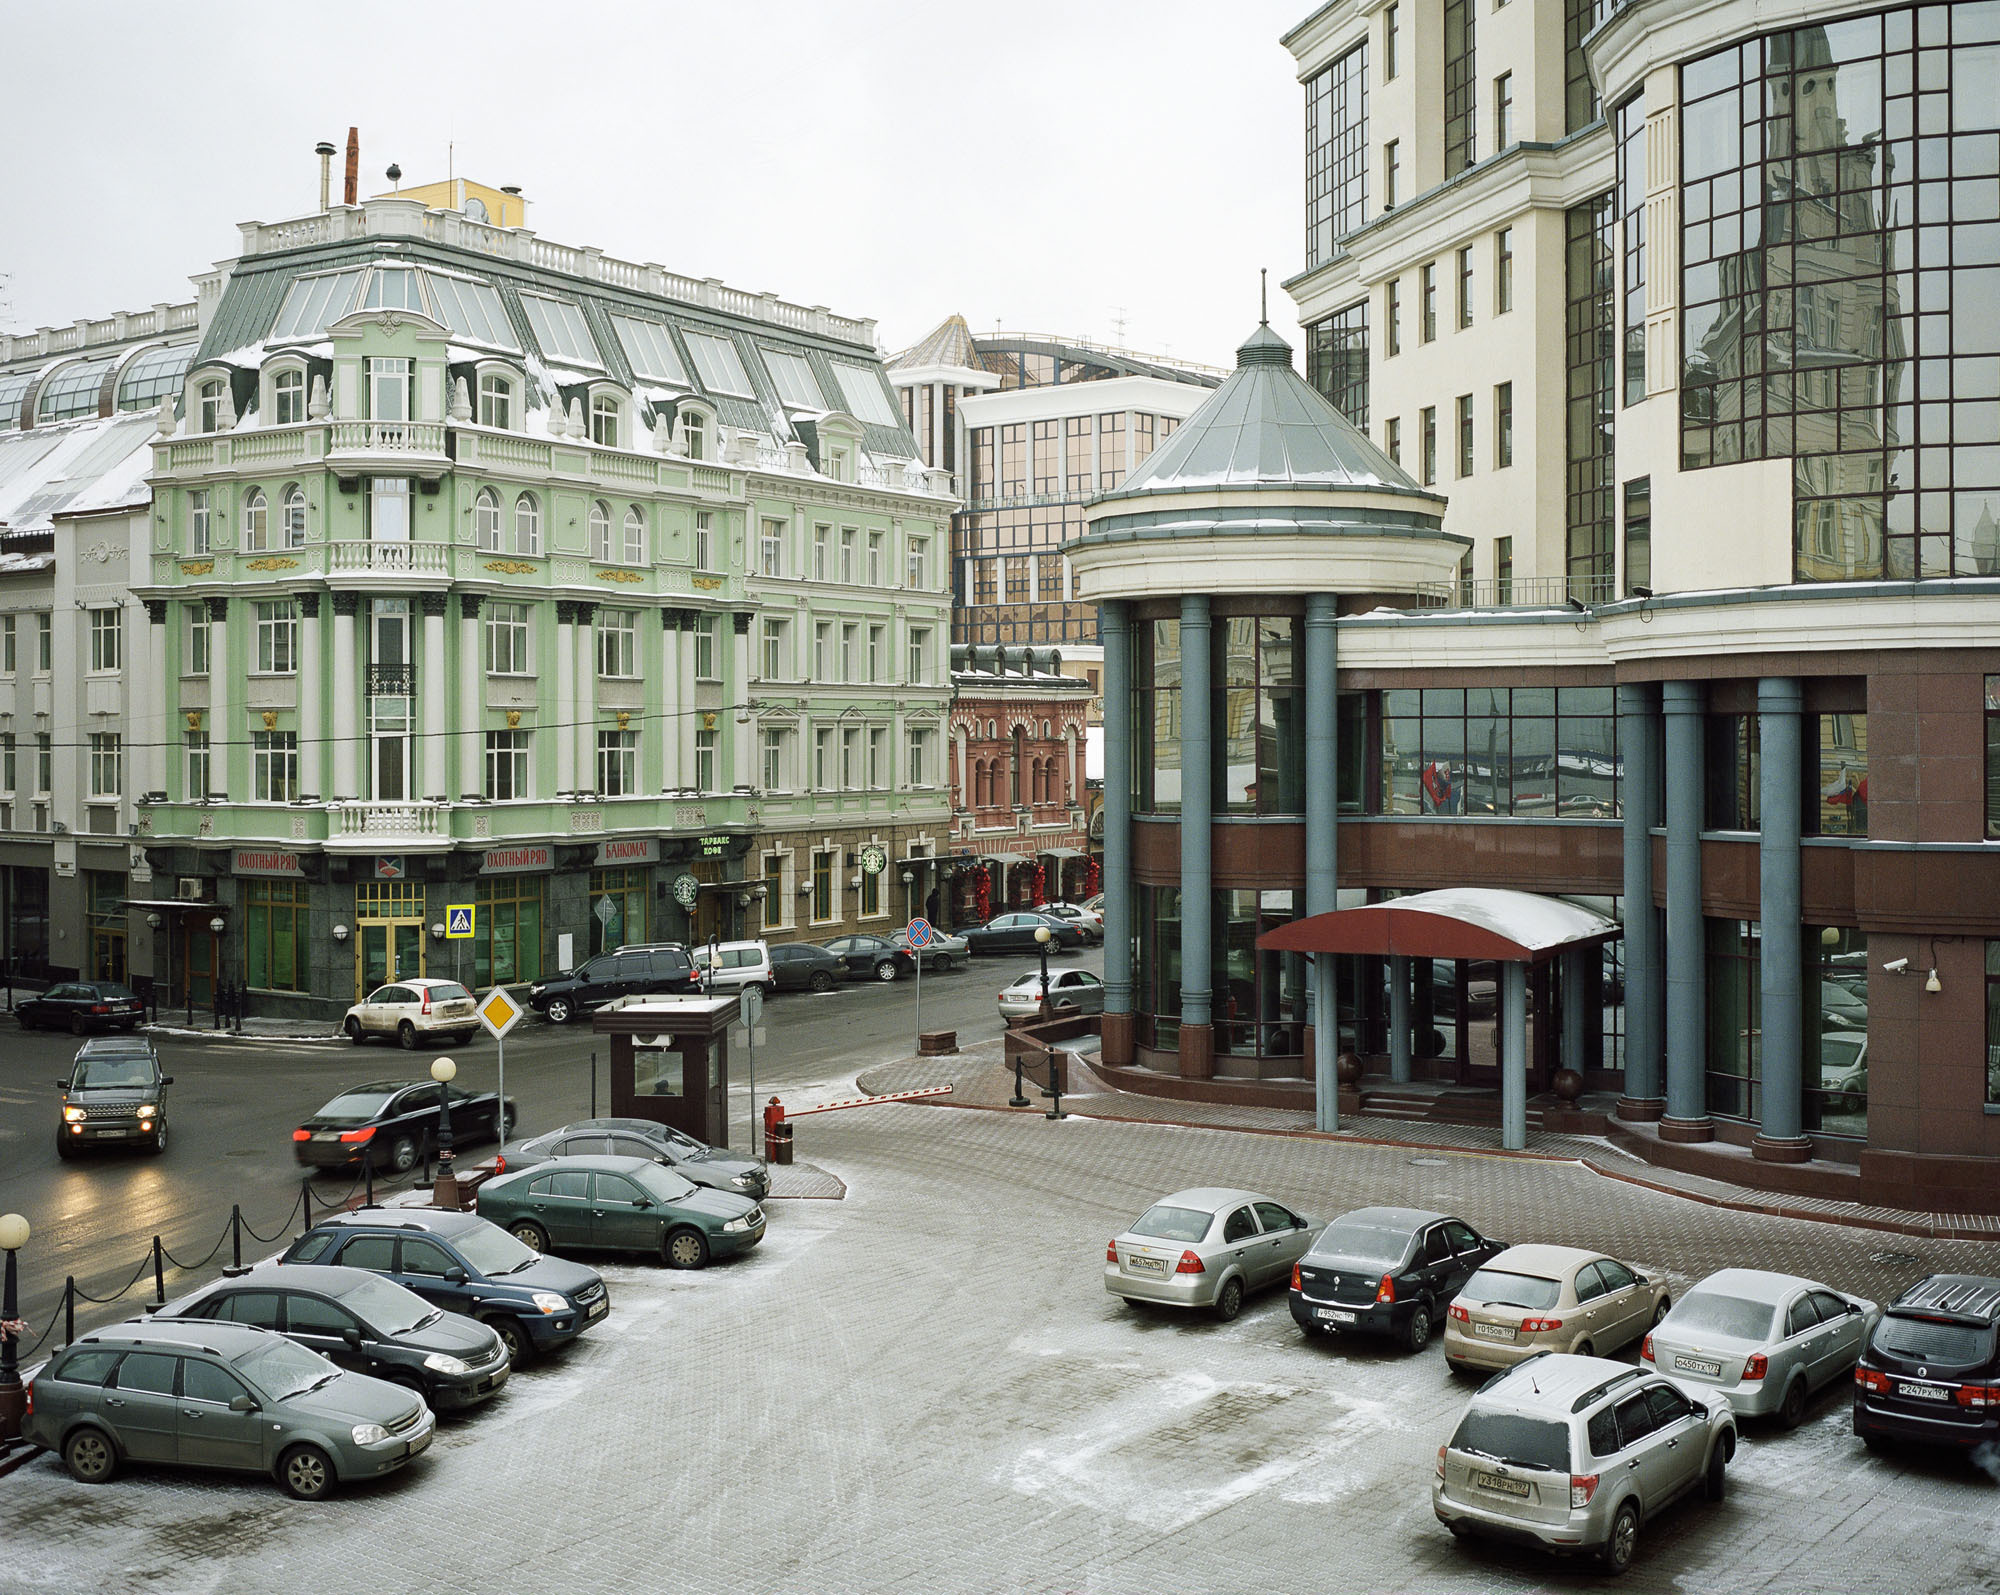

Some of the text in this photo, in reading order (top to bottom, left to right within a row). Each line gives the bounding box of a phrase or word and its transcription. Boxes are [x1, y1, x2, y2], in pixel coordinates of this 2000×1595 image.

[487, 848, 548, 868] ОХОТНЫЙ РЯД
[606, 840, 648, 858] БАНКОМАТ
[703, 846, 722, 855] КОФЕ
[238, 852, 297, 870] ОХОТНЫЙ РЯД
